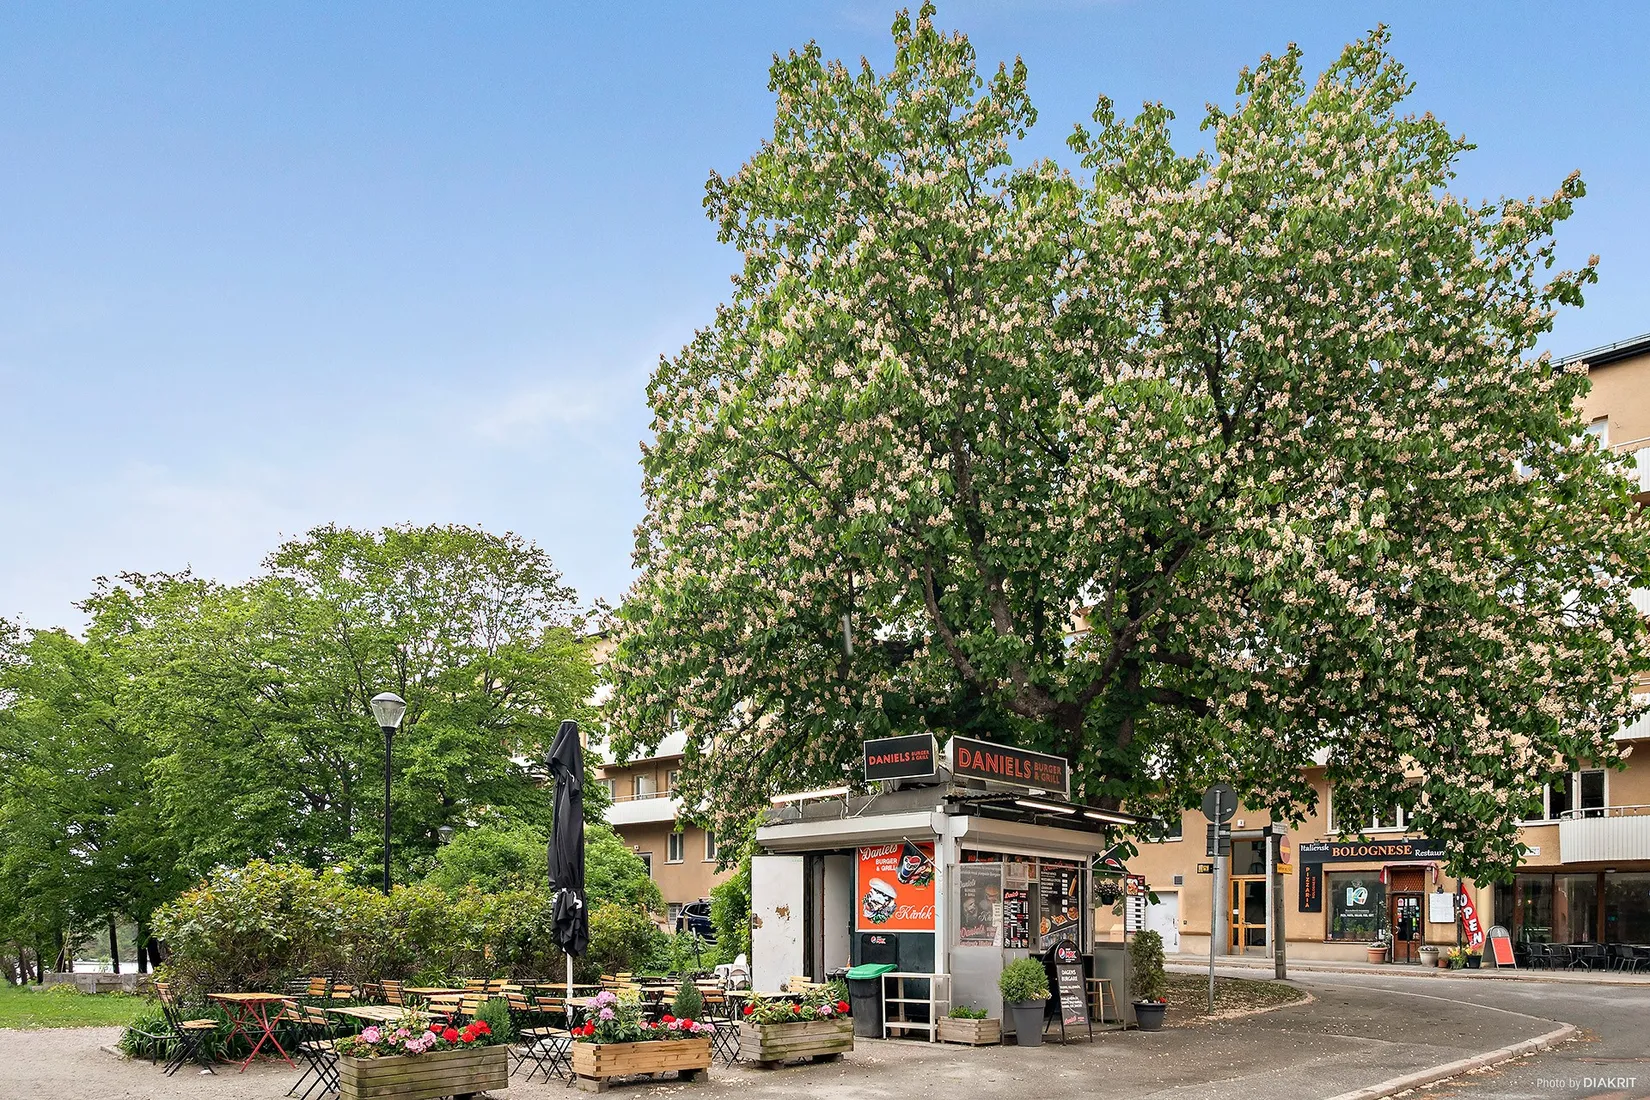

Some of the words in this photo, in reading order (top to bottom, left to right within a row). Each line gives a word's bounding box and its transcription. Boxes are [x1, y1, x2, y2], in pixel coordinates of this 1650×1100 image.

[868, 752, 911, 766] DANIELS
[958, 747, 1032, 779] DANIELS
[1034, 762, 1062, 775] BURGER
[1034, 772, 1039, 781] &
[1040, 773, 1060, 784] GRILL
[860, 844, 898, 861] Daniels
[1300, 844, 1330, 852] Italiensk
[1332, 845, 1412, 857] BOLOGNESE
[1415, 849, 1445, 857] Restaur
[895, 905, 935, 920] Kärlek
[1460, 894, 1482, 945] OPEN
